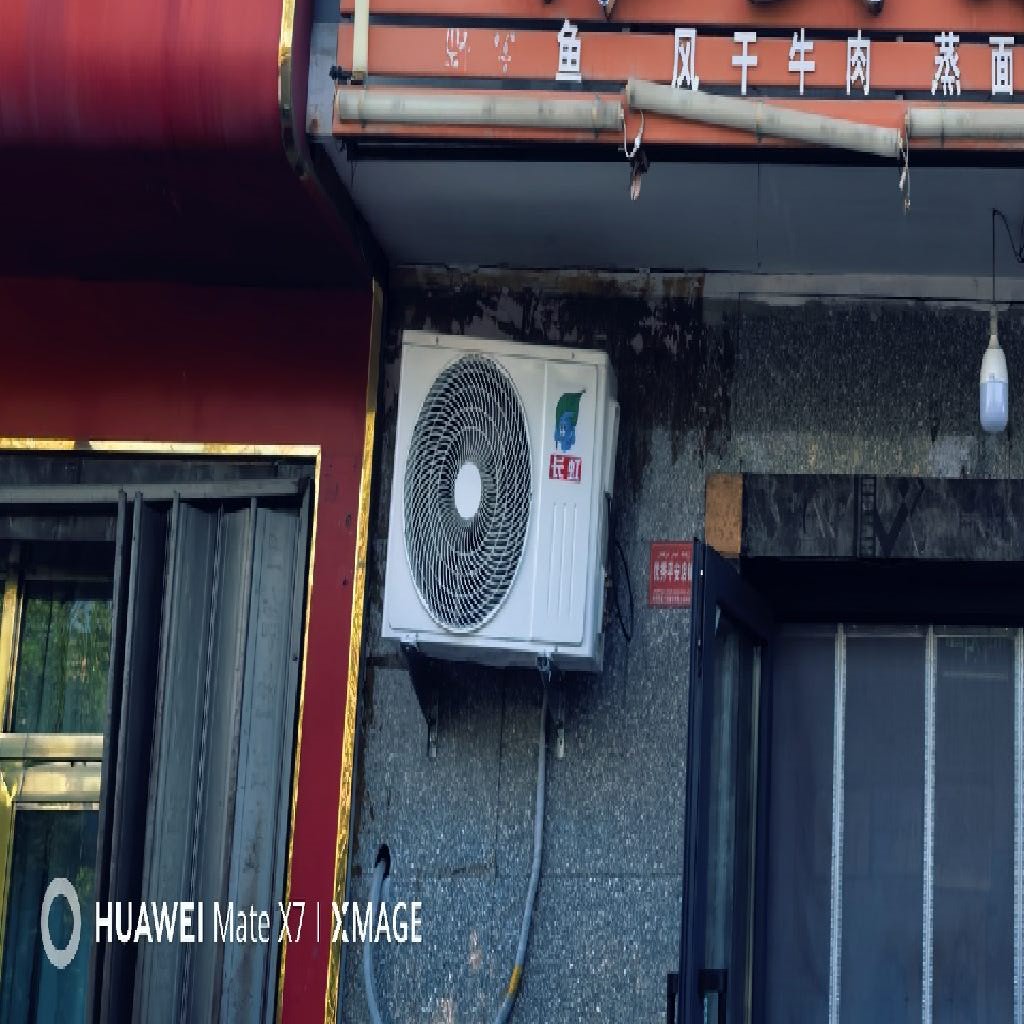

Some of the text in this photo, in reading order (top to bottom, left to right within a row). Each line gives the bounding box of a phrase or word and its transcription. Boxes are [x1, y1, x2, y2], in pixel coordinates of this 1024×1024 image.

[671, 27, 871, 96] 风干牛肉
[550, 456, 582, 480] 长虹
